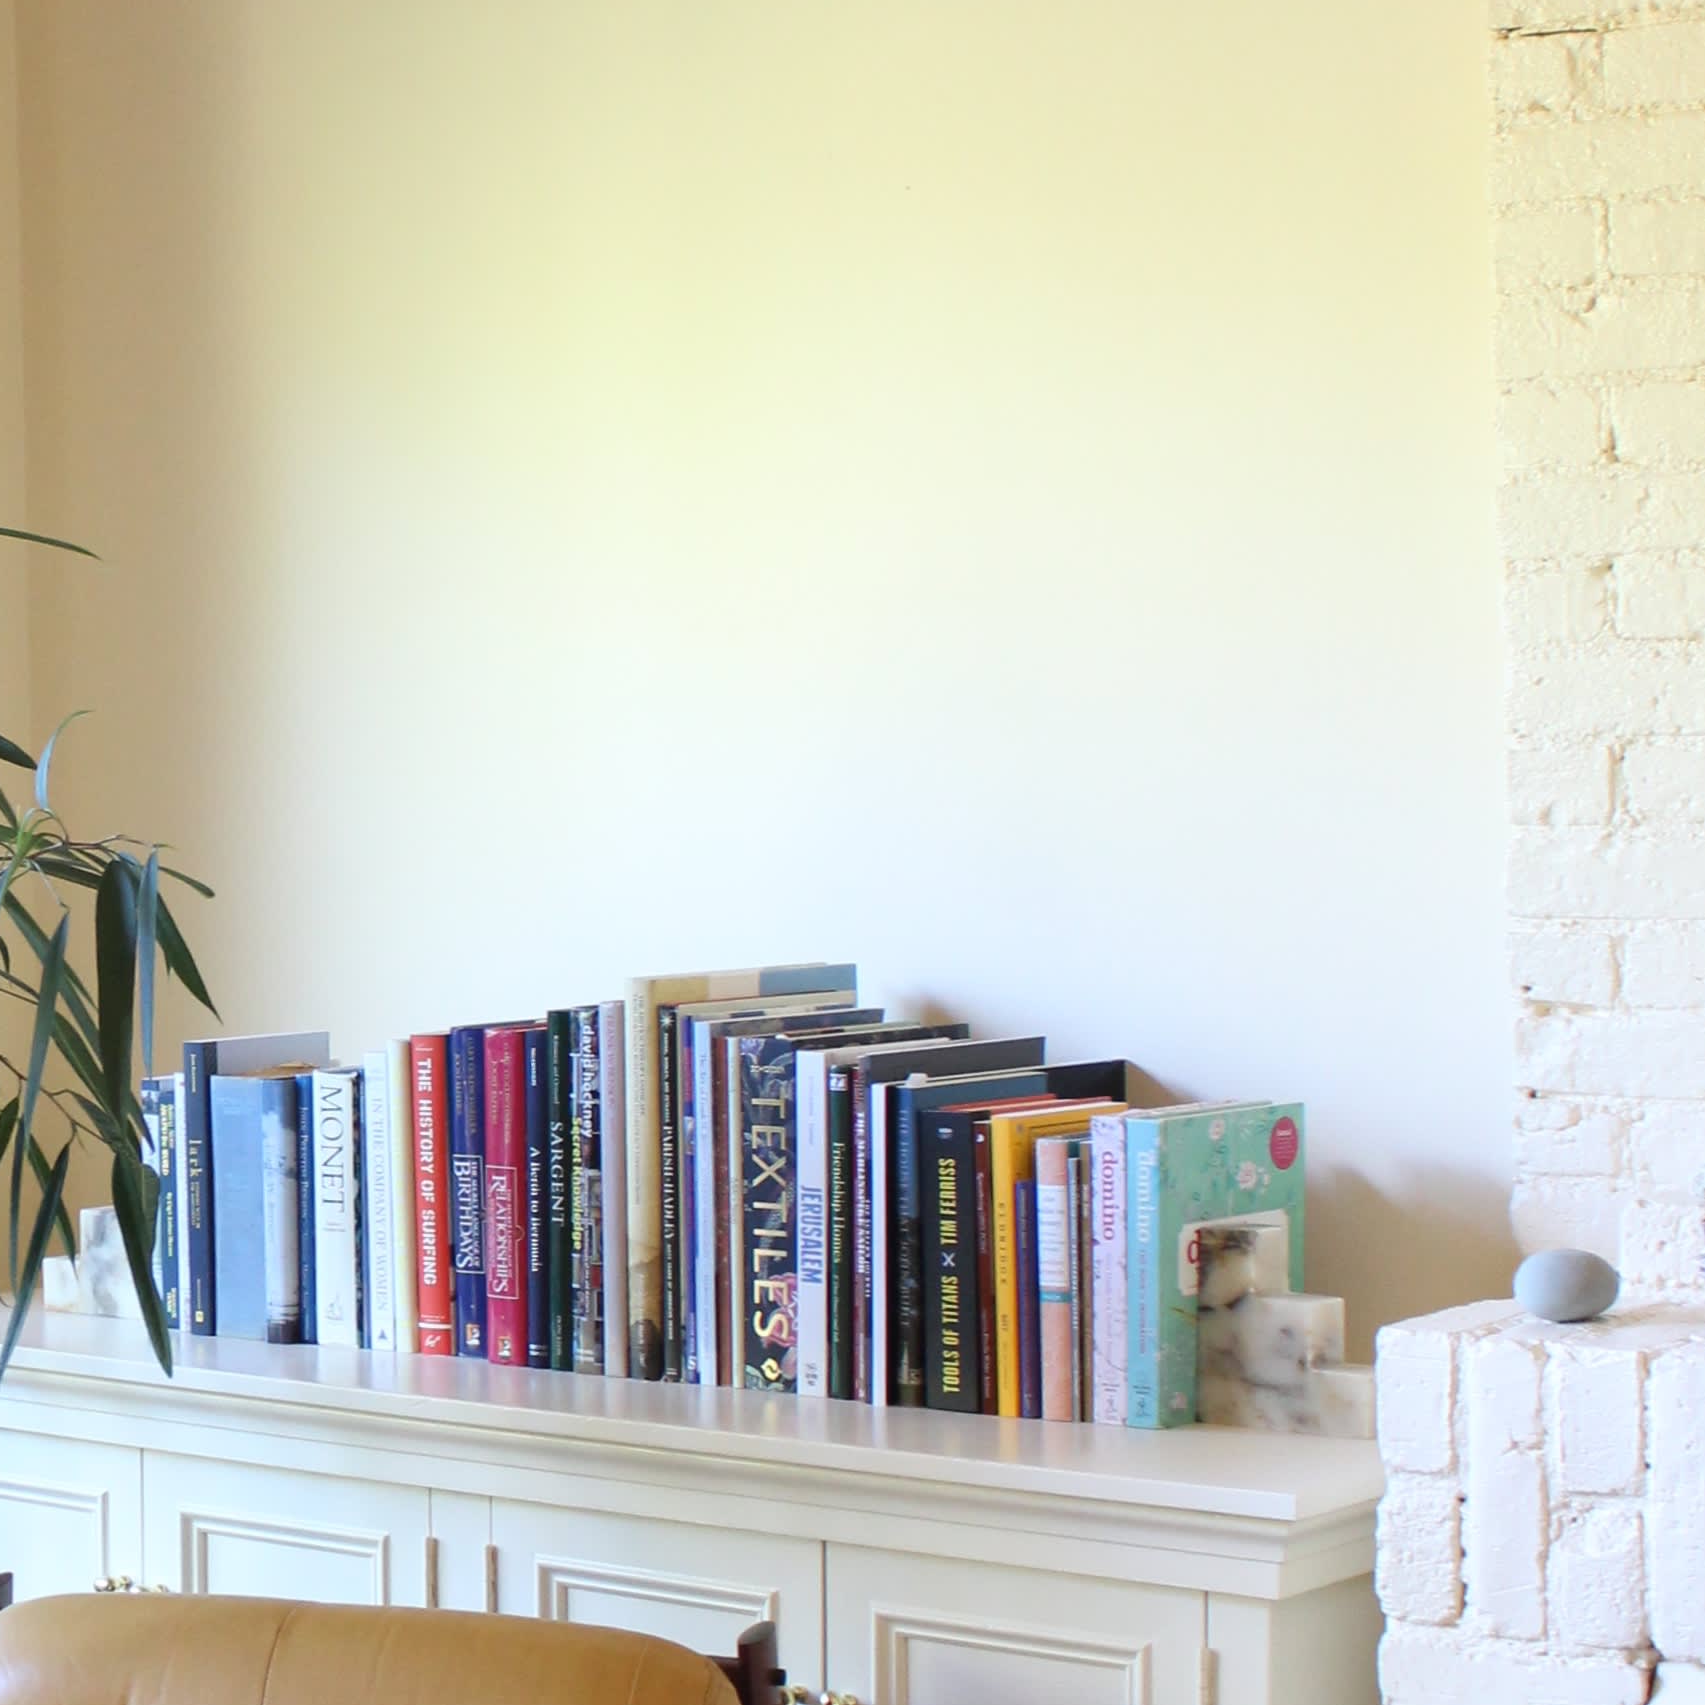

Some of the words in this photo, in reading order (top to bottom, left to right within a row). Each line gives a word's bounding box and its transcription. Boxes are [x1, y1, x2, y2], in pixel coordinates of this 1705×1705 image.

[418, 1058, 432, 1091] THE
[581, 1025, 595, 1070] david
[581, 1071, 595, 1138] hockney
[855, 1112, 865, 1136] THE
[189, 1139, 202, 1177] lark
[320, 1086, 345, 1213] MONET
[372, 1118, 384, 1151] THE
[419, 1099, 434, 1173] HISTORY
[530, 1146, 541, 1157] A
[570, 1116, 583, 1164] Secret
[373, 1154, 386, 1224] COMPANY
[421, 1180, 435, 1202] OF
[530, 1162, 541, 1196] Berth
[550, 1121, 564, 1227] SARGENT
[831, 1142, 845, 1212] Friendship
[939, 1158, 956, 1215] FERRISS
[1101, 1151, 1119, 1241] domino
[1136, 1151, 1156, 1243] domino
[453, 1160, 474, 1268] BIRTHDAYS
[489, 1175, 509, 1293] RELATIONSHIPS
[530, 1200, 541, 1213] to
[571, 1165, 584, 1250] Knowledge
[750, 1087, 788, 1338] TEXTILES
[940, 1220, 958, 1245] TIM
[375, 1230, 387, 1251] OF
[422, 1209, 437, 1285] SURFING
[530, 1217, 543, 1272] Bermuda
[800, 1185, 823, 1284] JERUSALEM
[833, 1216, 845, 1264] Homes
[376, 1253, 388, 1311] WOMEN
[941, 1276, 960, 1323] TITANS
[942, 1328, 960, 1346] OF
[942, 1350, 961, 1393] TOOLS
